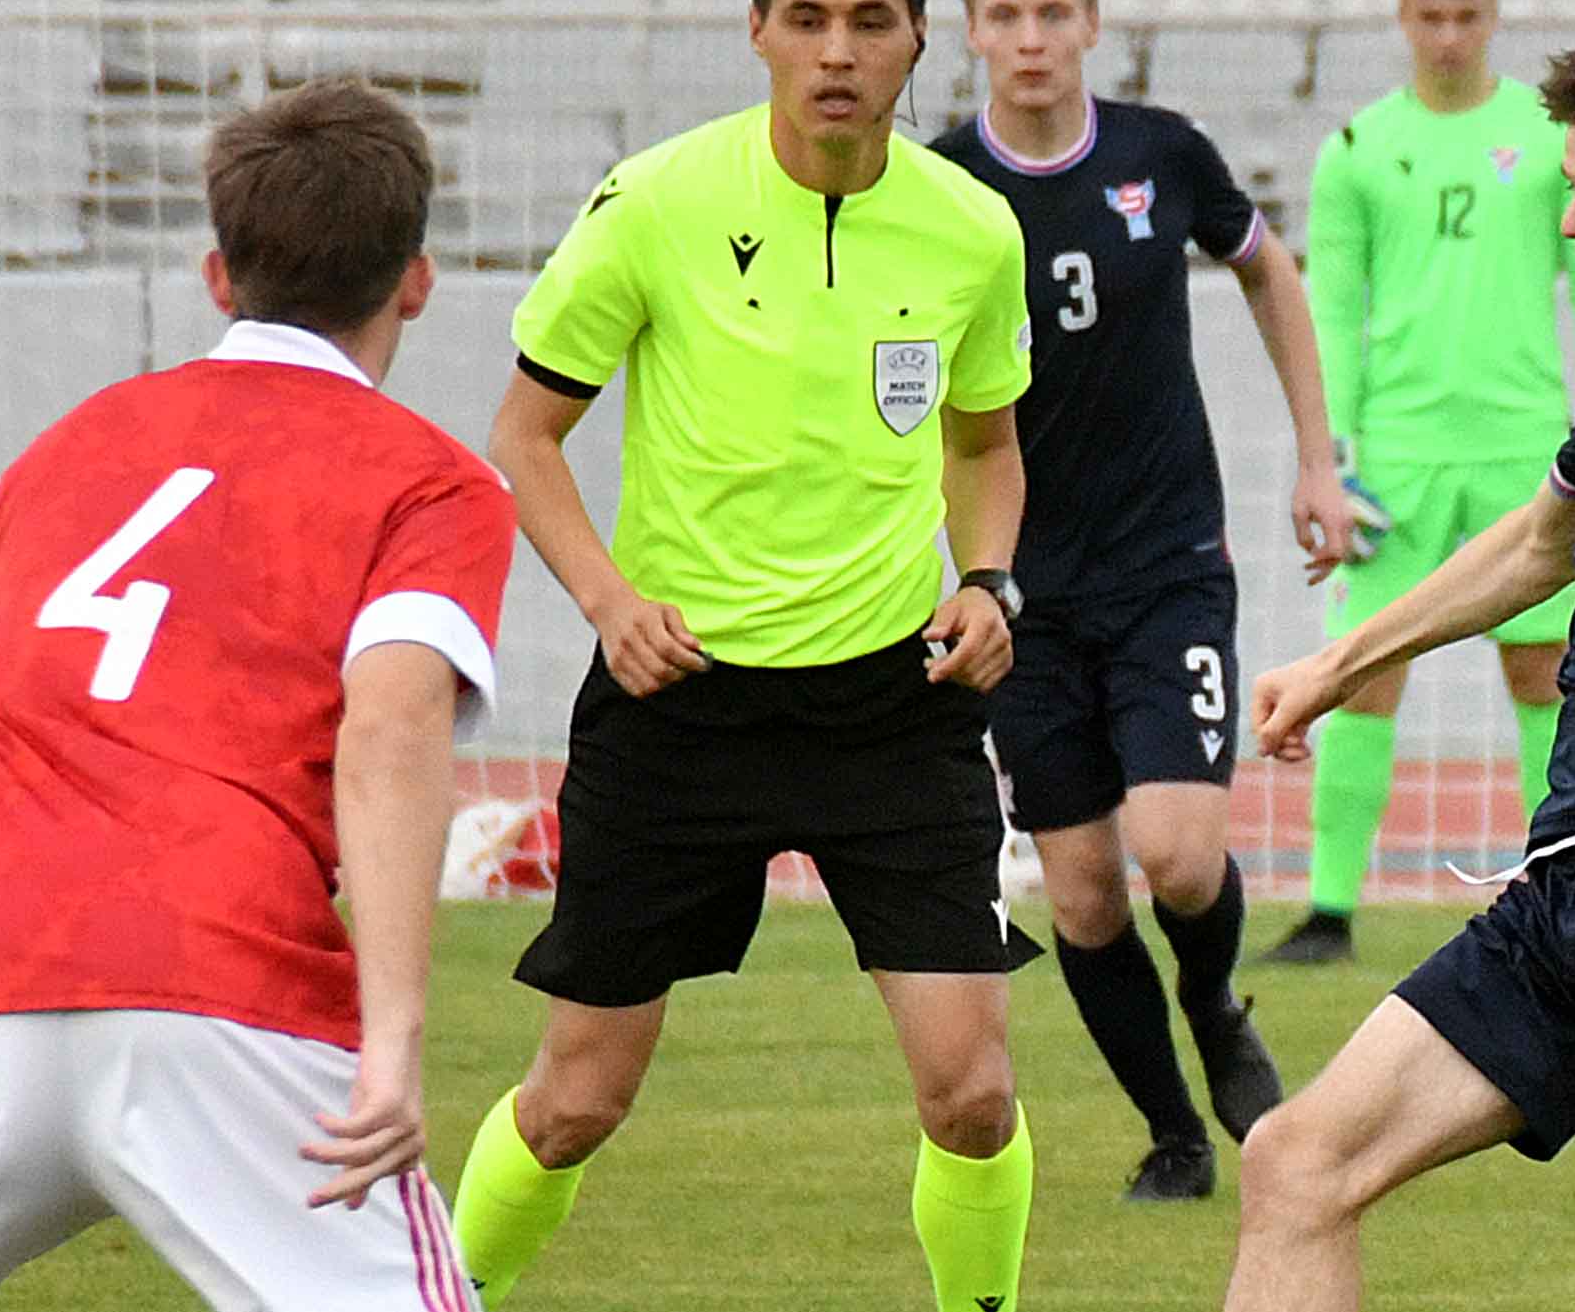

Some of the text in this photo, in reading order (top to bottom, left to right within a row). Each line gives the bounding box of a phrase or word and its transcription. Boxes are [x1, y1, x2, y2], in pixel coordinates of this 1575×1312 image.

[1433, 186, 1476, 240] 12
[1051, 251, 1098, 333] 3
[883, 394, 927, 406] OFFICIAL
[888, 381, 926, 392] MATCH
[37, 467, 216, 702] 4
[1185, 645, 1226, 722] 3
